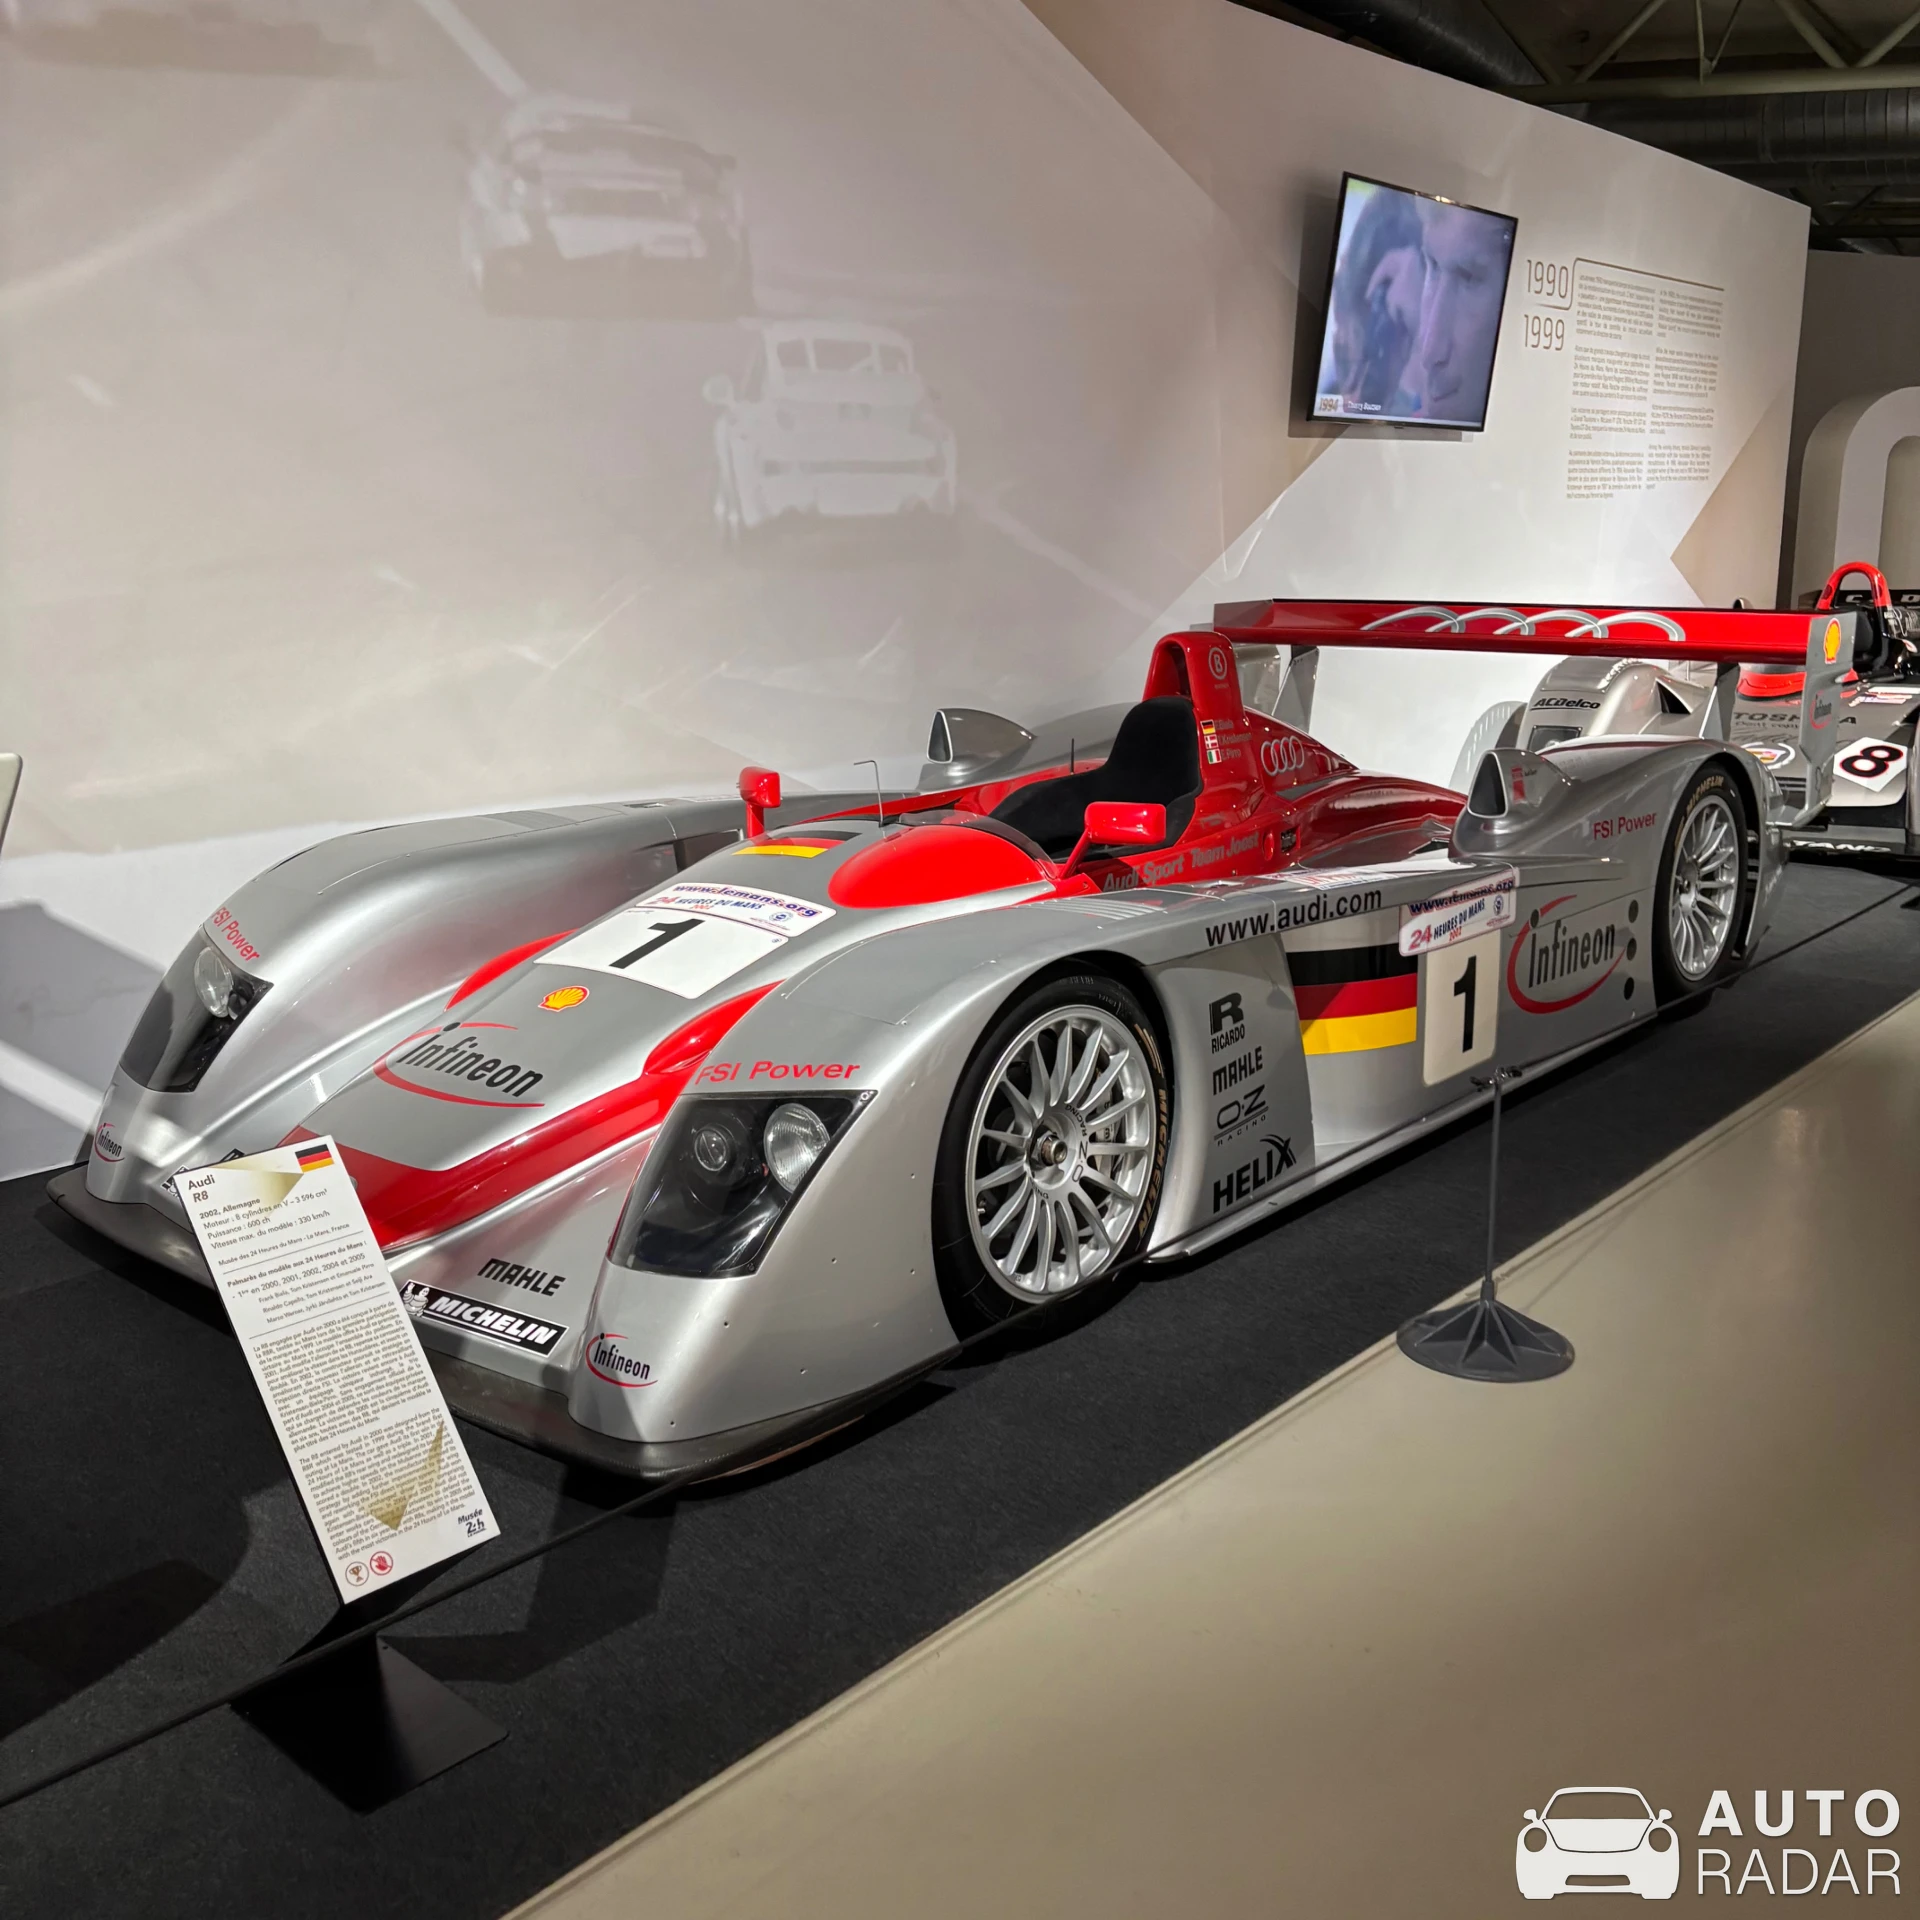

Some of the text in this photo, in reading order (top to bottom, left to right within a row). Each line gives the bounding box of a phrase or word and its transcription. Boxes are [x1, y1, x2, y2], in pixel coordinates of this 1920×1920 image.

[1527, 259, 1569, 299] 1990
[1524, 313, 1565, 351] 1999
[1534, 697, 1601, 709] ACDelco
[1839, 745, 1903, 778] 8
[1593, 812, 1657, 840] FSI Power
[1103, 831, 1260, 892] Audi Sport Team Joest
[650, 896, 679, 905] 24
[675, 896, 714, 905] HEURES
[728, 900, 766, 910] MANS
[672, 884, 819, 919] www.lemans.org
[1205, 889, 1382, 947] www.audi.com
[221, 920, 260, 961] Power
[1408, 924, 1432, 951] 24
[1433, 915, 1458, 940] HEURES
[1458, 909, 1468, 924] DU
[1468, 898, 1486, 919] MANS
[608, 918, 705, 970] 1
[1528, 909, 1616, 988] Infineon
[1209, 992, 1244, 1035] R
[1454, 955, 1476, 1053] 1
[1211, 1023, 1246, 1054] RICARDO
[396, 1022, 543, 1097] Infineon
[694, 1060, 860, 1085] FSI Power
[1212, 1045, 1263, 1096] MAHLE
[97, 1122, 123, 1157] Infineon
[1217, 1115, 1266, 1147] RACING
[188, 1174, 215, 1190] Audi
[1138, 1088, 1168, 1239] MICHELIN
[1213, 1136, 1295, 1214] HELIX
[192, 1190, 208, 1203] R8
[203, 1218, 229, 1229] Moteur
[242, 1206, 272, 1219] cylindres
[273, 1200, 282, 1209] en
[301, 1193, 314, 1201] 596
[222, 1198, 260, 1213] Allemagne
[207, 1216, 270, 1240] Puissance 600 ch
[210, 1238, 237, 1249] Vitesse
[267, 1221, 293, 1233] modèle
[298, 1215, 312, 1224] 330
[311, 1210, 330, 1220] km/h
[227, 1275, 257, 1287] Palmarès
[268, 1264, 292, 1275] modèle
[314, 1250, 336, 1260] Heures
[346, 1242, 363, 1250] Mans
[477, 1258, 566, 1296] MAHLE
[429, 1296, 558, 1345] MICHELIN
[593, 1332, 651, 1380] Infineon
[458, 1509, 482, 1523] Musée
